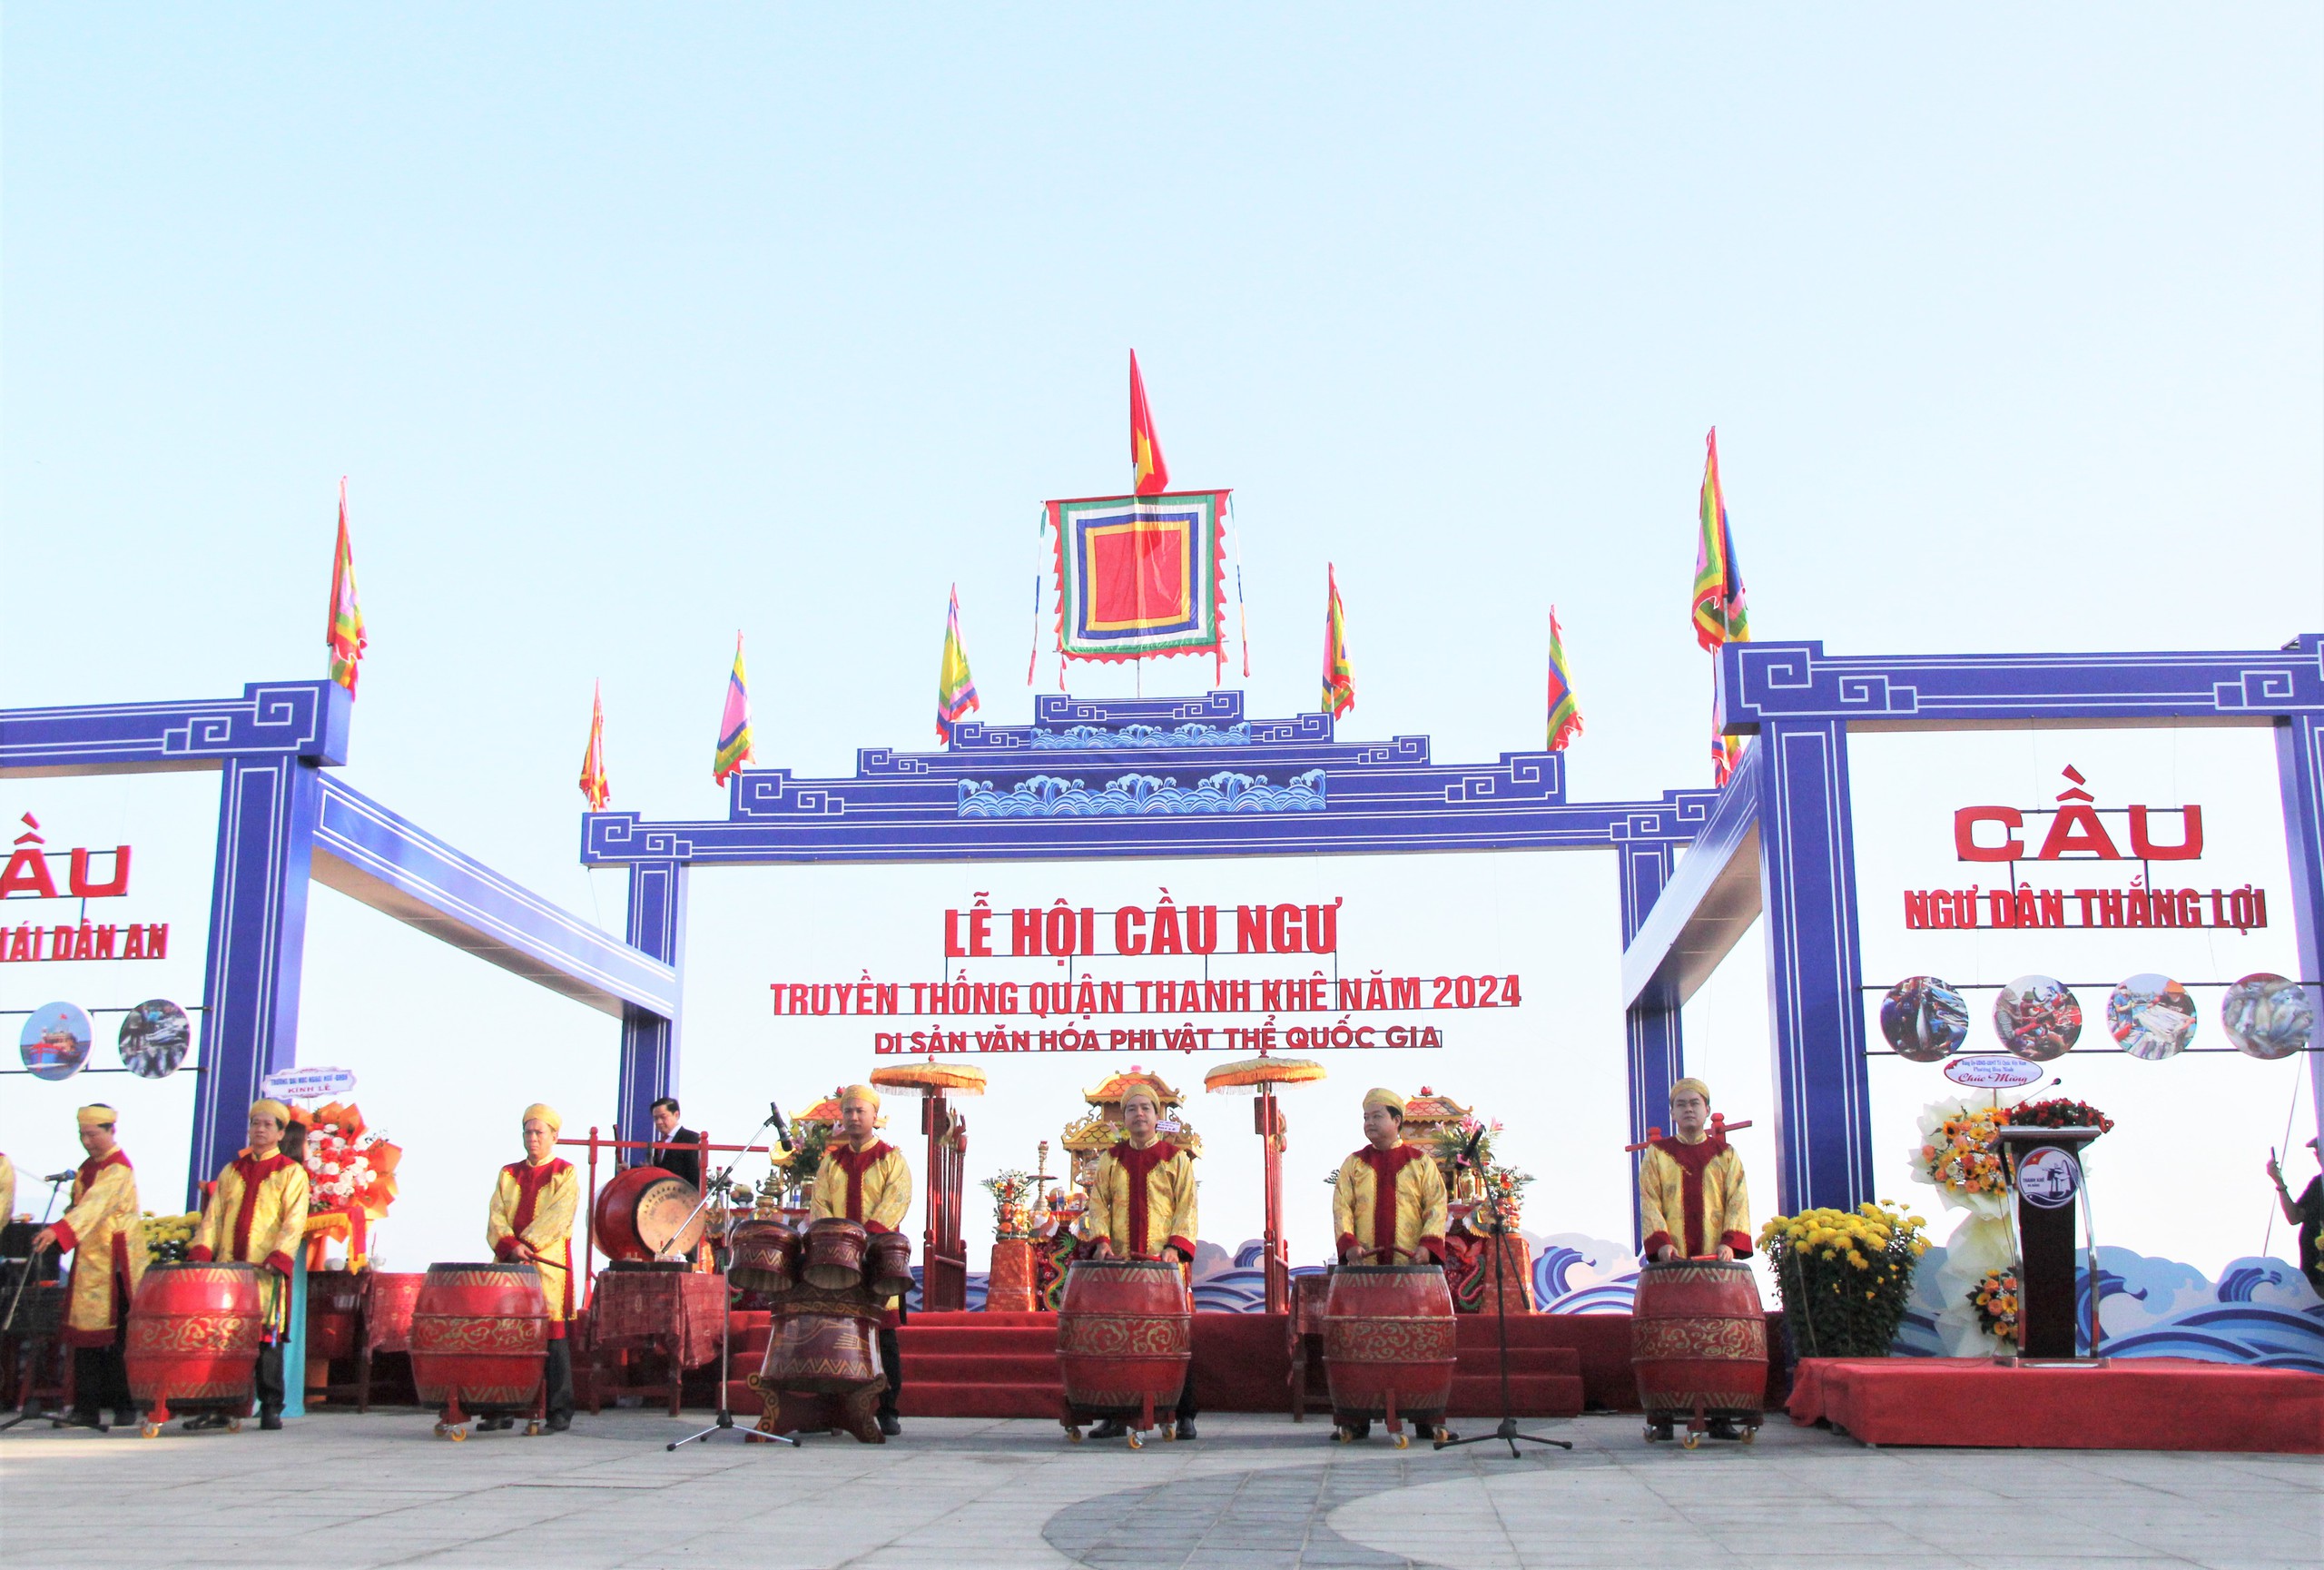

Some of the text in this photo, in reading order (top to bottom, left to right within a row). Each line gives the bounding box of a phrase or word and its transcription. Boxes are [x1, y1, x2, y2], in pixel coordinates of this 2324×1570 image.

[1954, 764, 2203, 863] CẦU
[944, 887, 1344, 967] LỄ HỘI CẦU NGƯ
[1904, 874, 2268, 936] NGƯ DÂN THẮNG LỢI
[51, 917, 117, 962] DÂN
[123, 923, 170, 960] AN
[770, 968, 1522, 1020] TRUYỀN THỐNG QUẬN THANH KHÊ NĂM 2024
[875, 1013, 1441, 1054] DI SẢN VĂN HÓA PHI VẬT THỂ QUỐC GIA
[1958, 1072, 1985, 1082] Chúc
